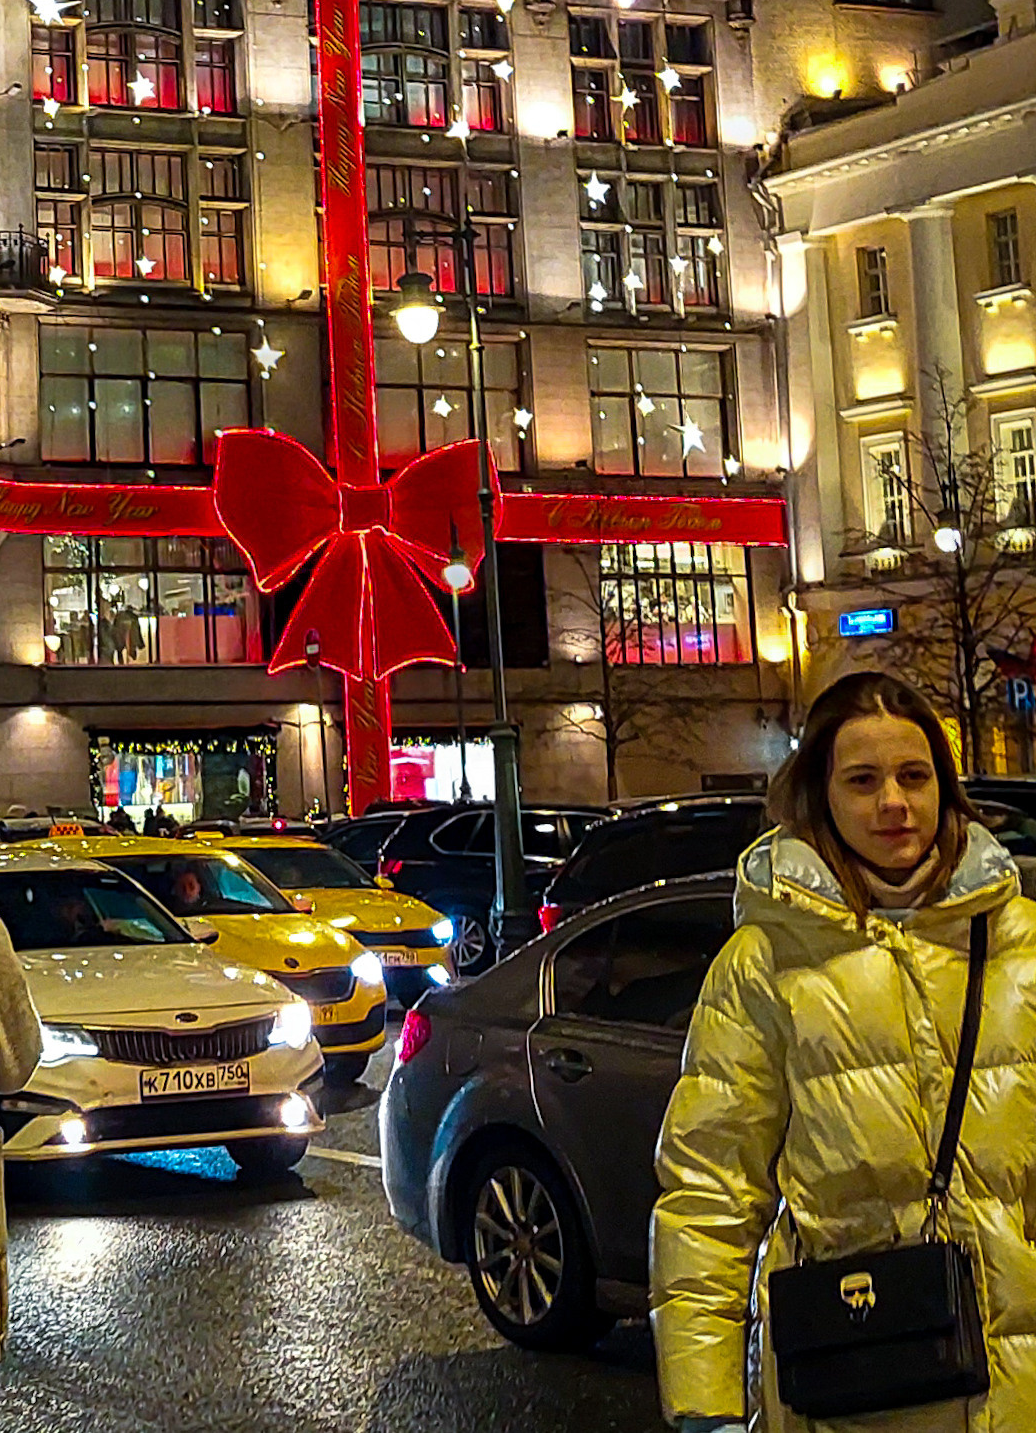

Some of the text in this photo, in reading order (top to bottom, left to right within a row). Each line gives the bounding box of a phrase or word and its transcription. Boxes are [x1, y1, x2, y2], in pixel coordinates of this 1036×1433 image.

[322, 3, 352, 61] Year
[323, 68, 348, 117] New
[47, 492, 95, 517] New
[104, 492, 160, 525] Year
